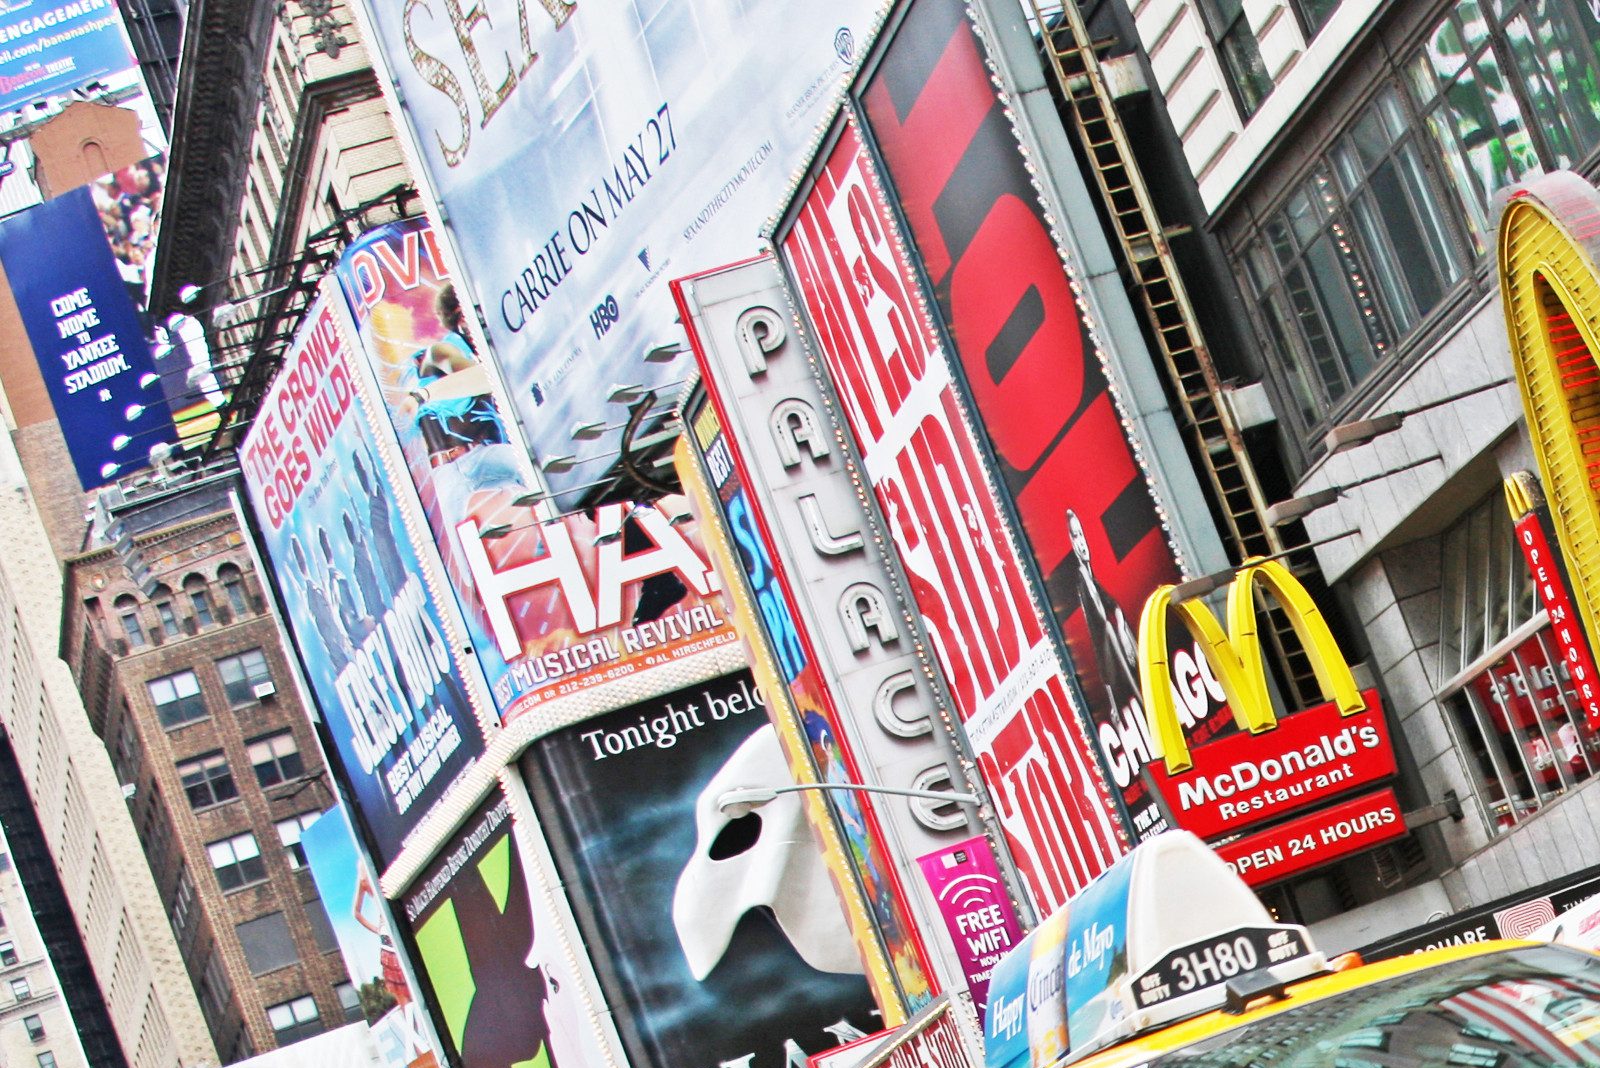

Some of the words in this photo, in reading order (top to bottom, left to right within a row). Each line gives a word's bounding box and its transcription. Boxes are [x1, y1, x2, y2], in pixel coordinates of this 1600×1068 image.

[501, 230, 573, 333] CARRIE
[568, 188, 608, 255] ON
[602, 133, 652, 219] MAY
[647, 102, 676, 166] 27
[51, 287, 92, 317] COME
[57, 307, 100, 339] HOME
[589, 294, 619, 341] HBO
[61, 334, 120, 371] YANKEE
[76, 331, 91, 345] TO
[278, 306, 340, 434] CROWD
[264, 435, 312, 529] GOES
[735, 306, 968, 833] PALACE
[335, 622, 413, 775] JERSEY
[384, 571, 450, 710] BOYS
[509, 637, 620, 693] MUSICAL
[621, 604, 724, 655] REVIVAL
[672, 631, 737, 658] HIRSCHFELD
[1551, 604, 1566, 625] 24
[1560, 628, 1600, 718] HOURS
[581, 702, 705, 762] Tonight
[1098, 638, 1228, 788] CHIAGO
[386, 750, 413, 795] BEST
[408, 705, 453, 767] MUSICAL
[1177, 725, 1381, 811] McDonald's
[1220, 762, 1355, 820] Restaurant
[1286, 831, 1318, 858] 24
[1318, 805, 1396, 846] HOURS
[956, 904, 1005, 936] FREE
[966, 926, 1011, 957] WIFI
[979, 953, 1000, 968] NOW
[991, 993, 1026, 1040] Happy
[1068, 939, 1082, 980] de
[1082, 921, 1115, 971] Mayo
[1171, 936, 1258, 992] 3H80
